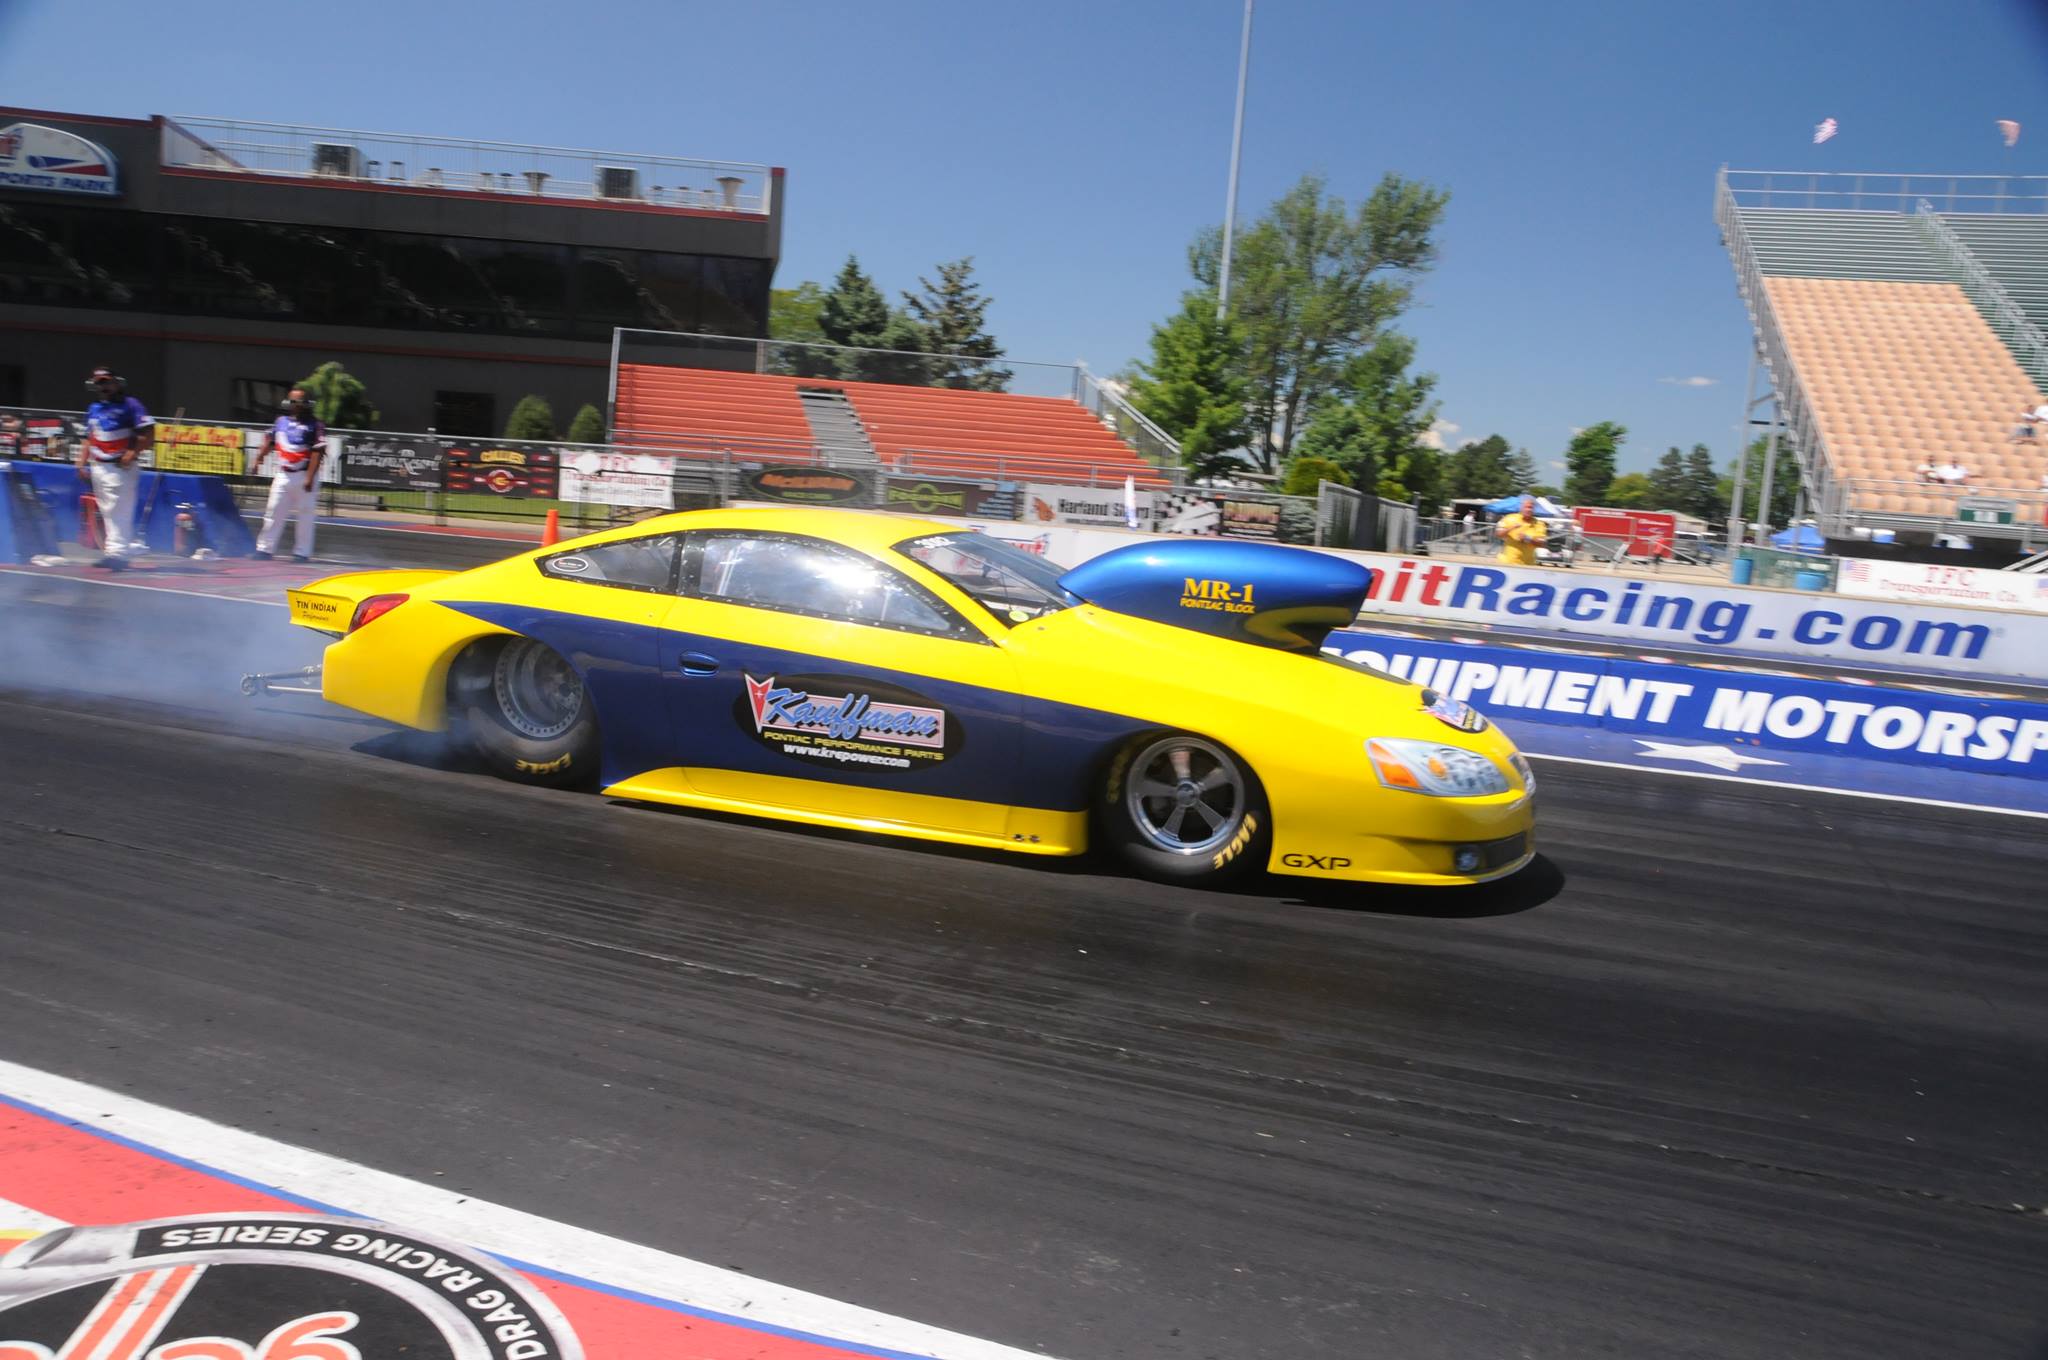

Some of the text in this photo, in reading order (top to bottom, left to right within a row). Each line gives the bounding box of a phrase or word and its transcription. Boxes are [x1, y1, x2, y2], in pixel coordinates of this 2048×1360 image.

[1183, 577, 1254, 603] MR-1
[296, 600, 337, 613] TIN INDIAN
[1180, 597, 1256, 614] PONTIAC BLOCK
[1366, 561, 1990, 660] itRacing.com
[765, 687, 938, 739] Kauffman
[764, 731, 944, 761] PONTIAC PERFORMANCE PARTS
[1282, 853, 1351, 870] GXP
[160, 1226, 548, 1360] DRAG RACING SERIES
